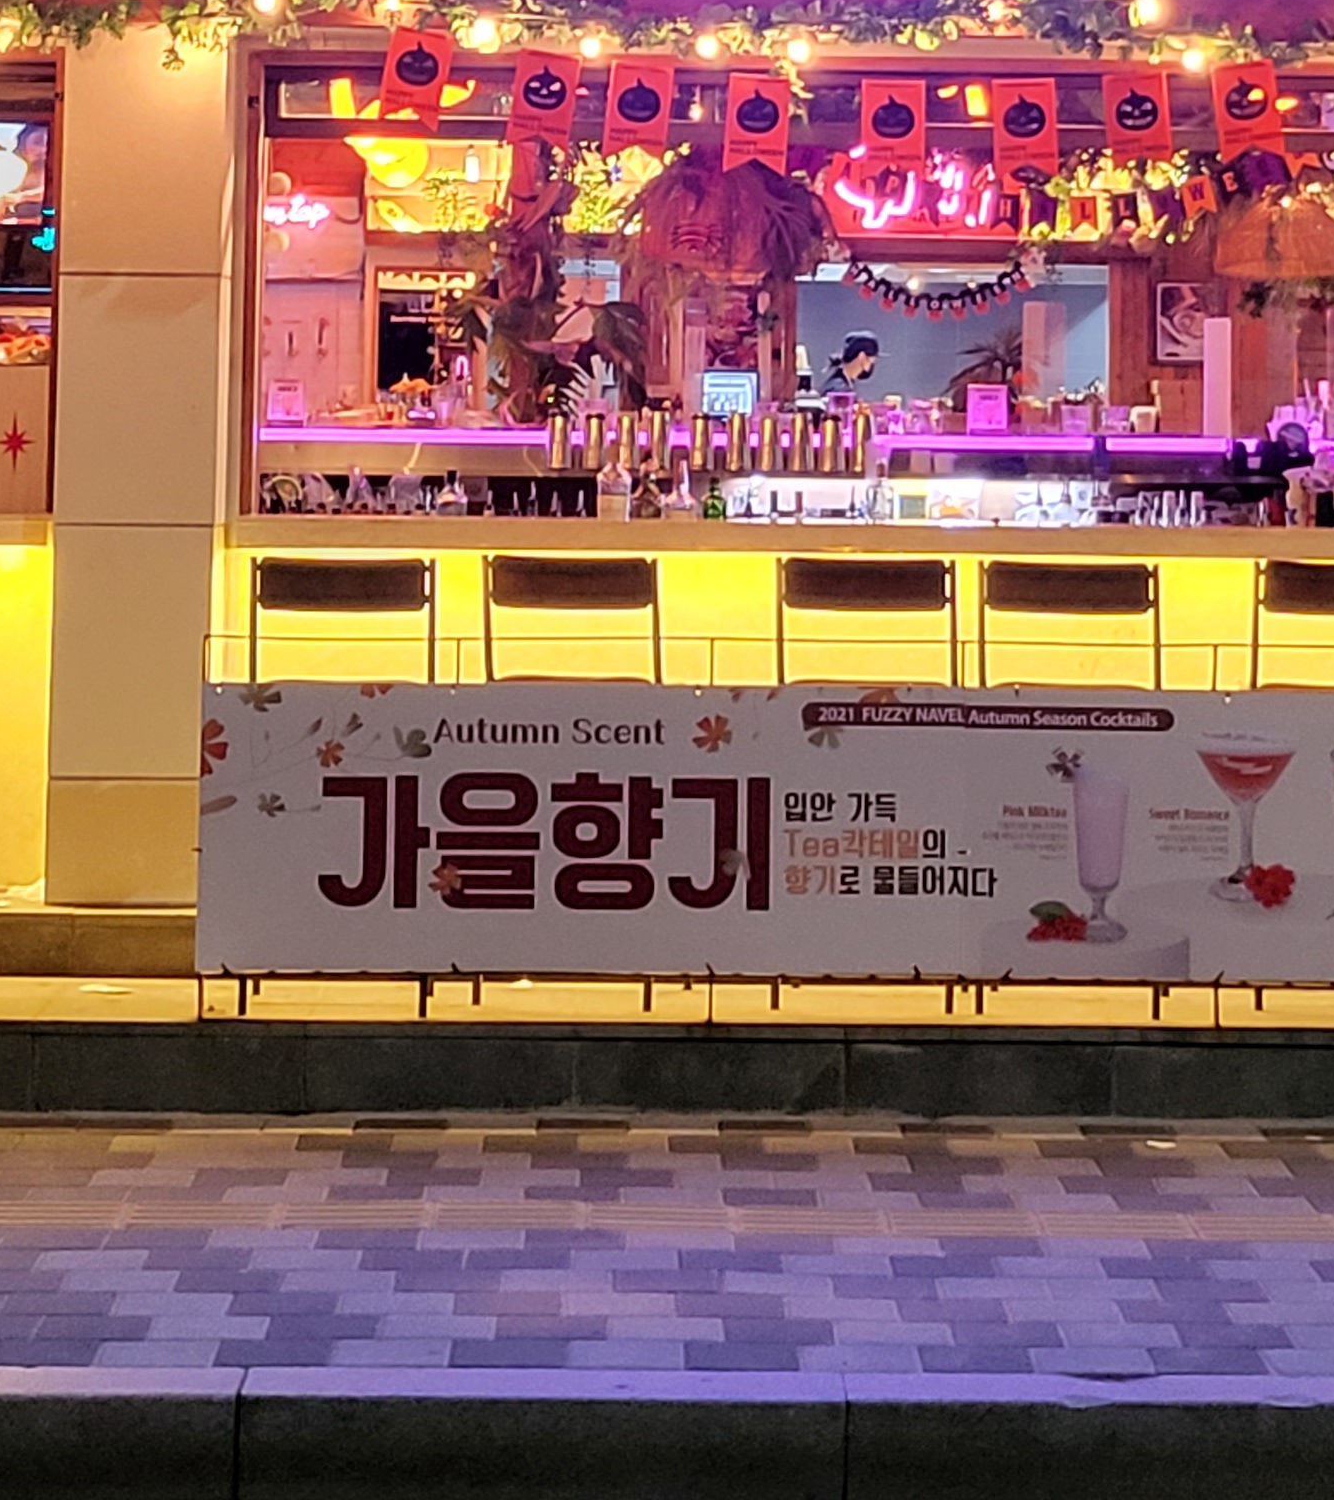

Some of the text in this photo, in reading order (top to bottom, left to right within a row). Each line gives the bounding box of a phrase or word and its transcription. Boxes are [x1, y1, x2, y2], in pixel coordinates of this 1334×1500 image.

[433, 717, 666, 745] Autumn Scent
[817, 707, 1159, 728] 2021 FUZZY NAVEL Autumn Season Cocktails
[783, 792, 897, 823] 입안 가득
[317, 771, 772, 912] 가을향기
[782, 828, 946, 860] Tea칵테일의
[783, 864, 998, 898] 향기로 물들어지다
